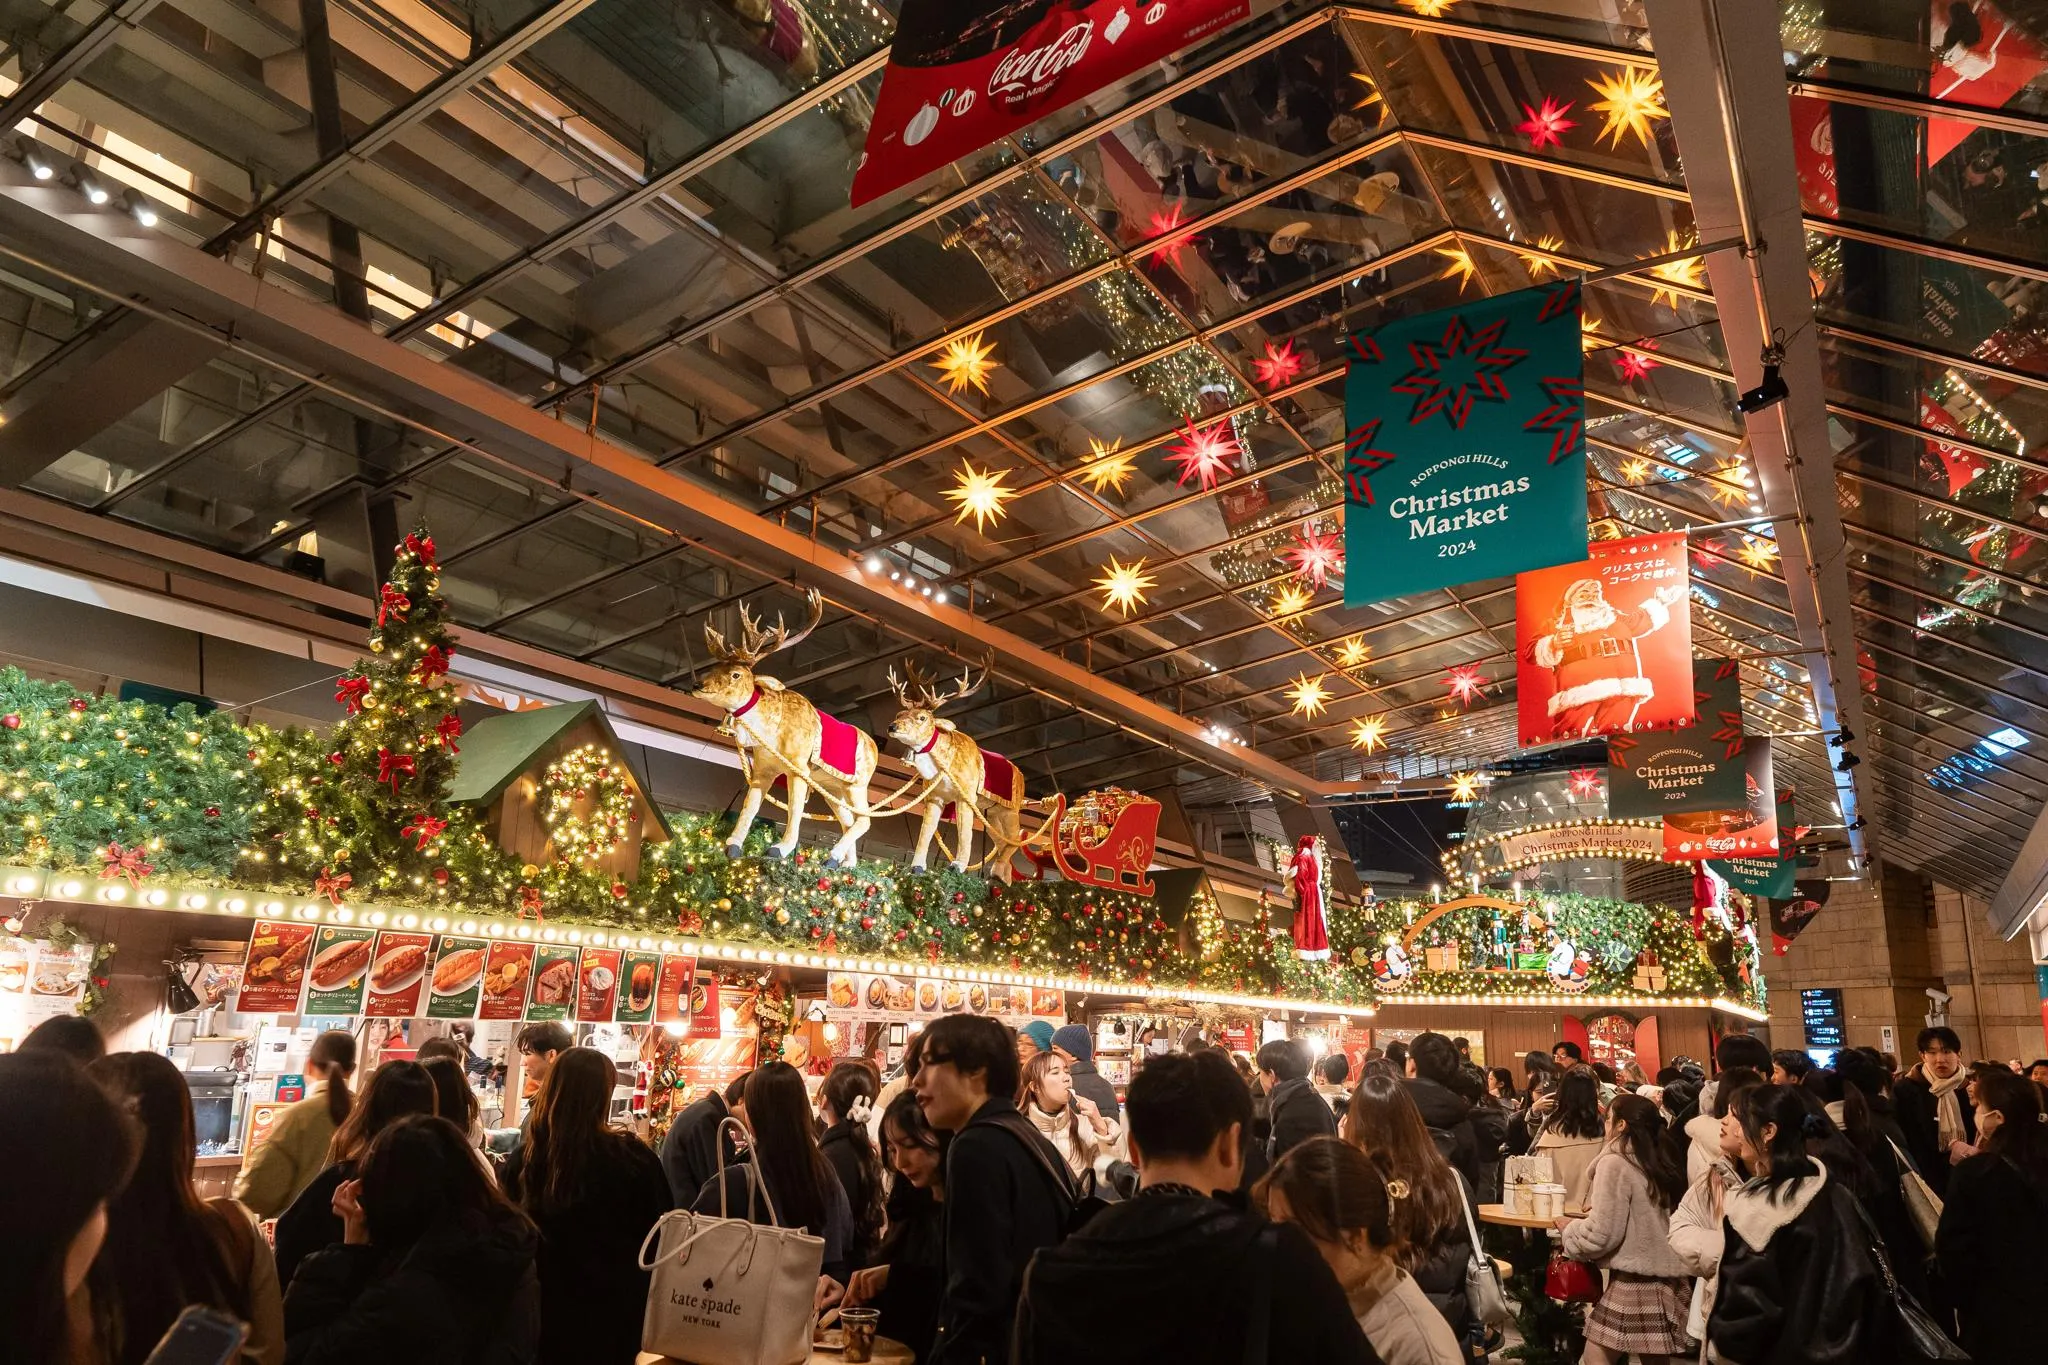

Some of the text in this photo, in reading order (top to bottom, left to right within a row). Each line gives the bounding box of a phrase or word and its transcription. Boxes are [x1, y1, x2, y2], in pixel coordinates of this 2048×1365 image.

[988, 19, 1094, 96] Coca-Cola
[1005, 93, 1024, 104] Real
[1410, 454, 1509, 488] ROPPONGI HILLS
[1389, 475, 1531, 519] Christmas
[1408, 503, 1509, 540] Market
[1437, 539, 1477, 557] 2024
[1647, 748, 1682, 763] ROPPONGI
[1635, 763, 1716, 779] Christmas
[1648, 775, 1704, 790] Market
[1664, 791, 1687, 800] 2024
[1550, 828, 1623, 839] ROPPONGI HILLS
[1522, 838, 1653, 855] Christmas Market 2024
[1732, 865, 1770, 878] Market
[670, 1288, 742, 1316] kate spade
[682, 1315, 721, 1329] NEW YORK
